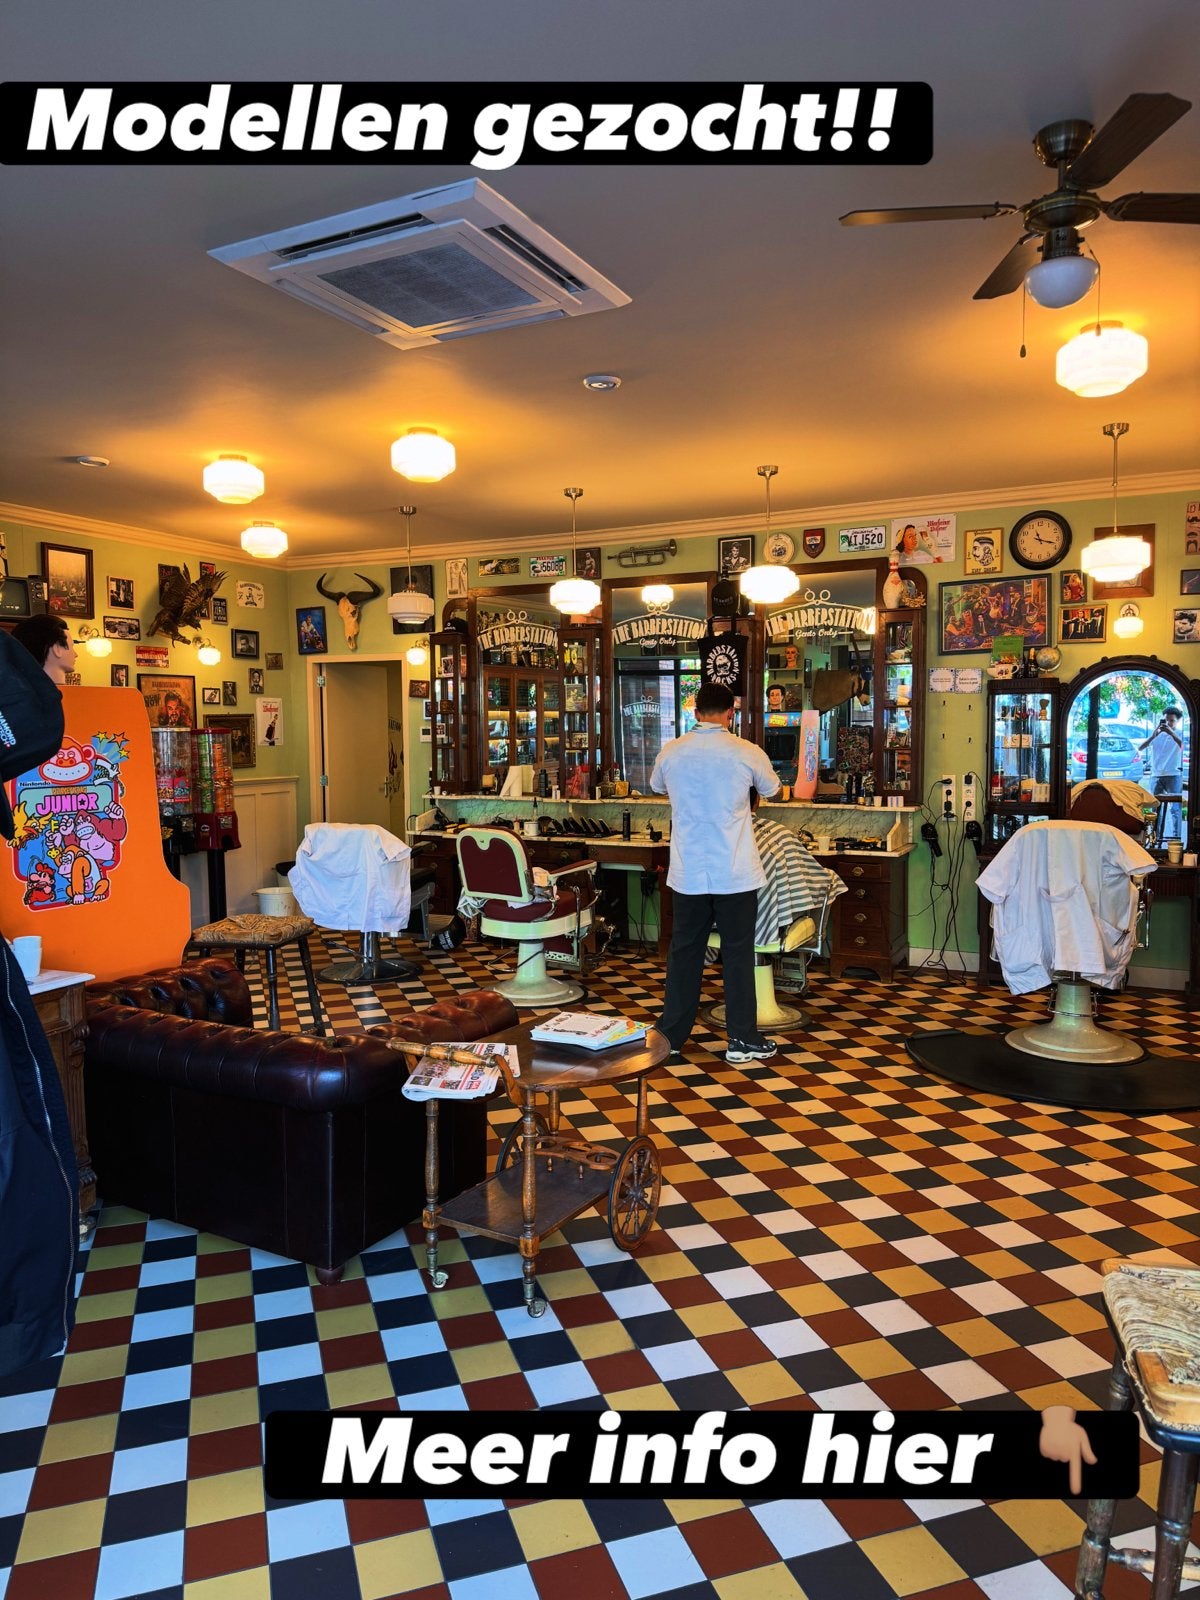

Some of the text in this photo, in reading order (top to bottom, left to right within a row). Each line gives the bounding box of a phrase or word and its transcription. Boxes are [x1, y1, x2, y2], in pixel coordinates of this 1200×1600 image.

[477, 626, 559, 651] THE BARBERSTATION
[612, 618, 708, 645] THE BARBERSTATION
[795, 628, 838, 639] Gents Only
[36, 792, 99, 815] JUNIOR
